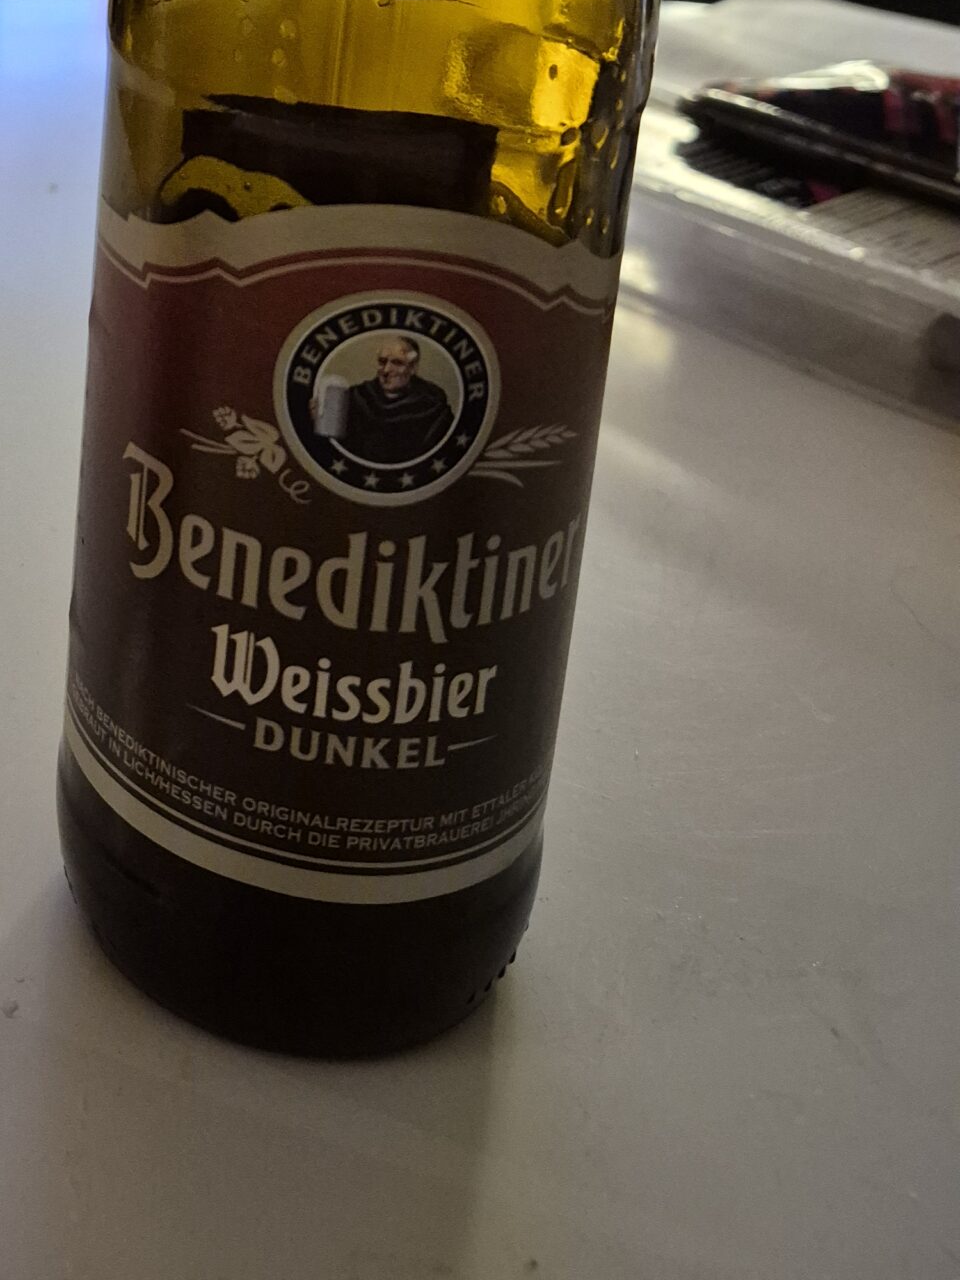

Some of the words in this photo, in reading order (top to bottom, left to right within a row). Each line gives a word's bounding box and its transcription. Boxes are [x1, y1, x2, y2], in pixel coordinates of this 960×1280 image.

[292, 308, 485, 402] BENEDIKTINER
[122, 441, 582, 644] Benediktiner
[211, 623, 498, 724] Weissbier
[96, 705, 238, 806] BENEDIKTINISCHER
[242, 797, 435, 834] ORIGINALREZEPTUR
[439, 808, 469, 827] MIT
[108, 736, 121, 758] IN
[124, 751, 227, 822] LICH/HESSEN
[233, 811, 303, 843] DURCH
[307, 831, 341, 849] DIE
[346, 815, 494, 852] PRIVATBRAUEREI
[252, 719, 447, 770] DUNKEL
